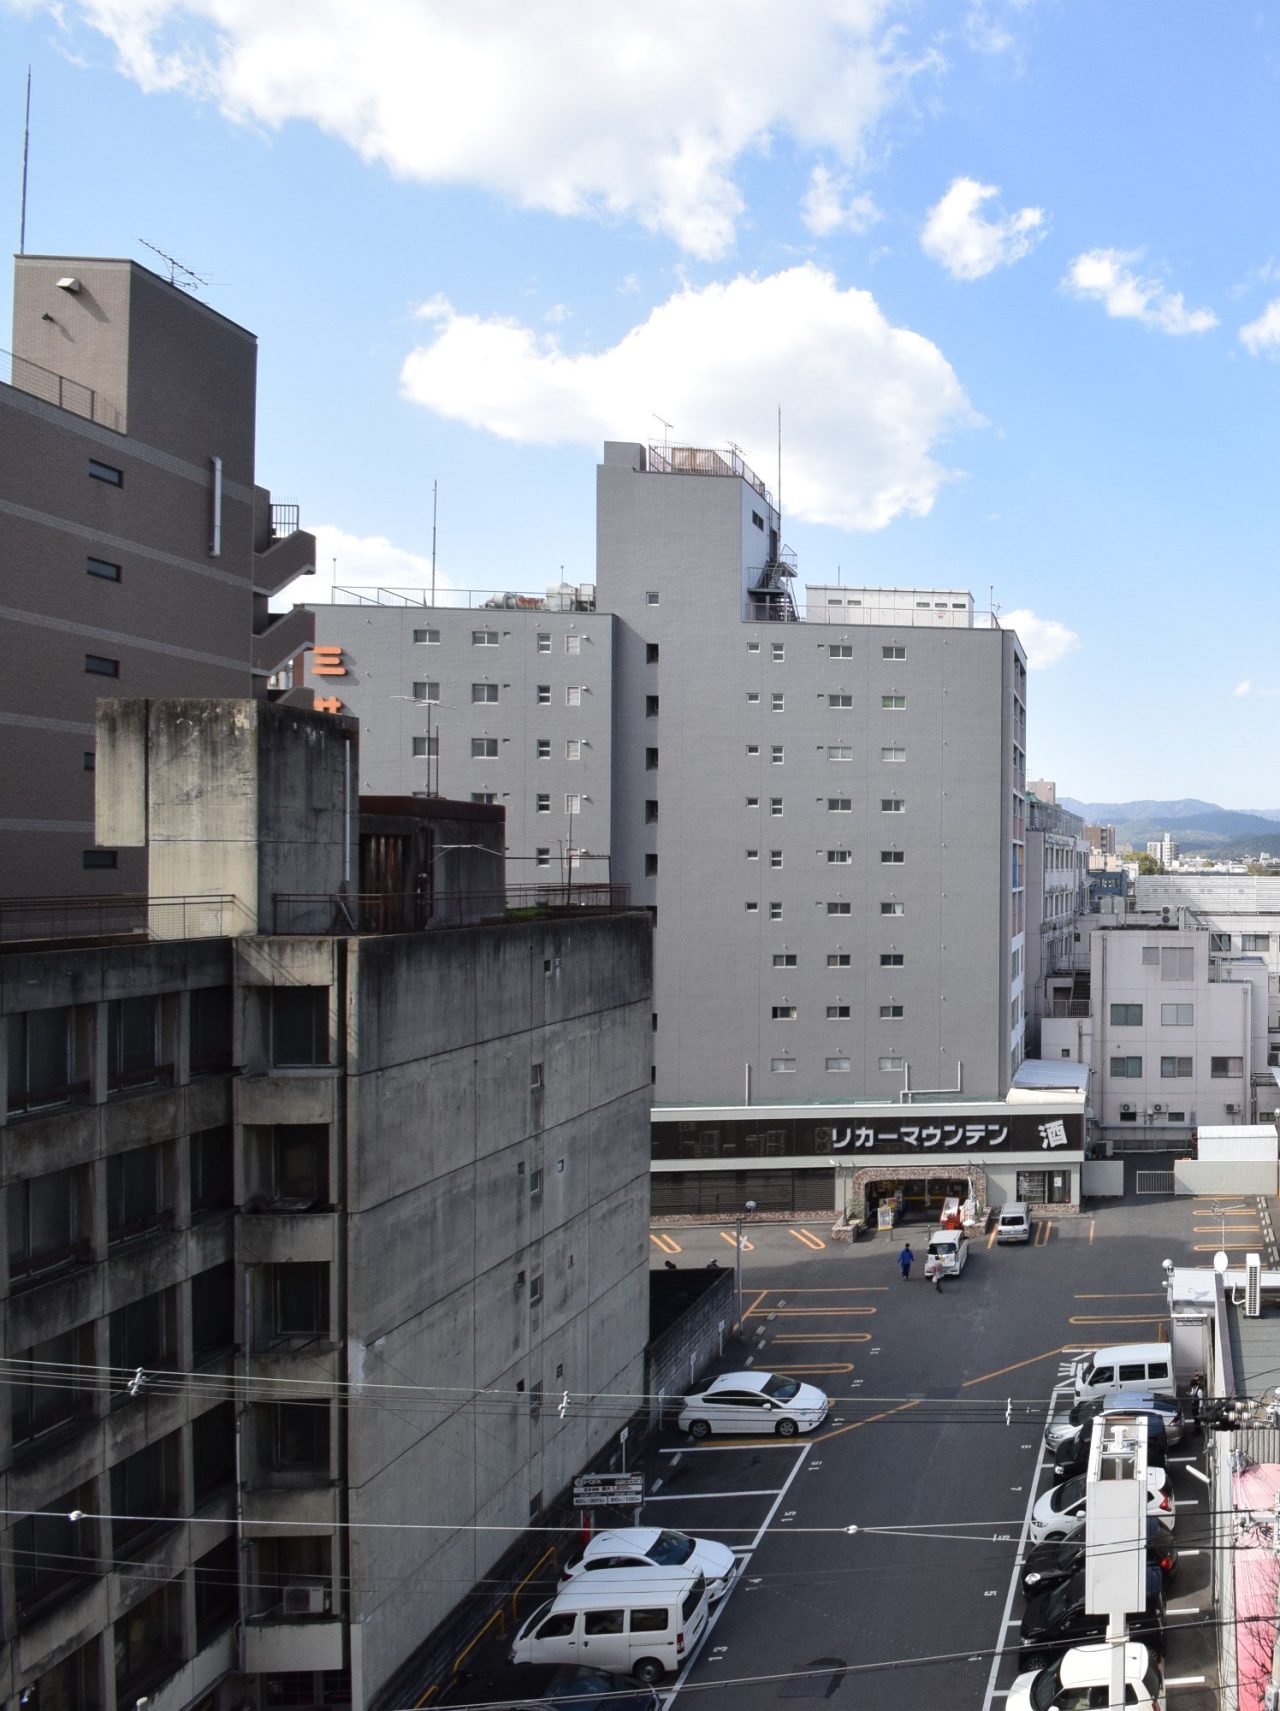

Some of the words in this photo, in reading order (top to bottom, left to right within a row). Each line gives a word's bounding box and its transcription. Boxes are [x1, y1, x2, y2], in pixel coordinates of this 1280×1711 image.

[832, 1124, 1008, 1148] リカーマウンテン
[1038, 1119, 1068, 1149] 酒
[708, 1646, 729, 1661] 13
